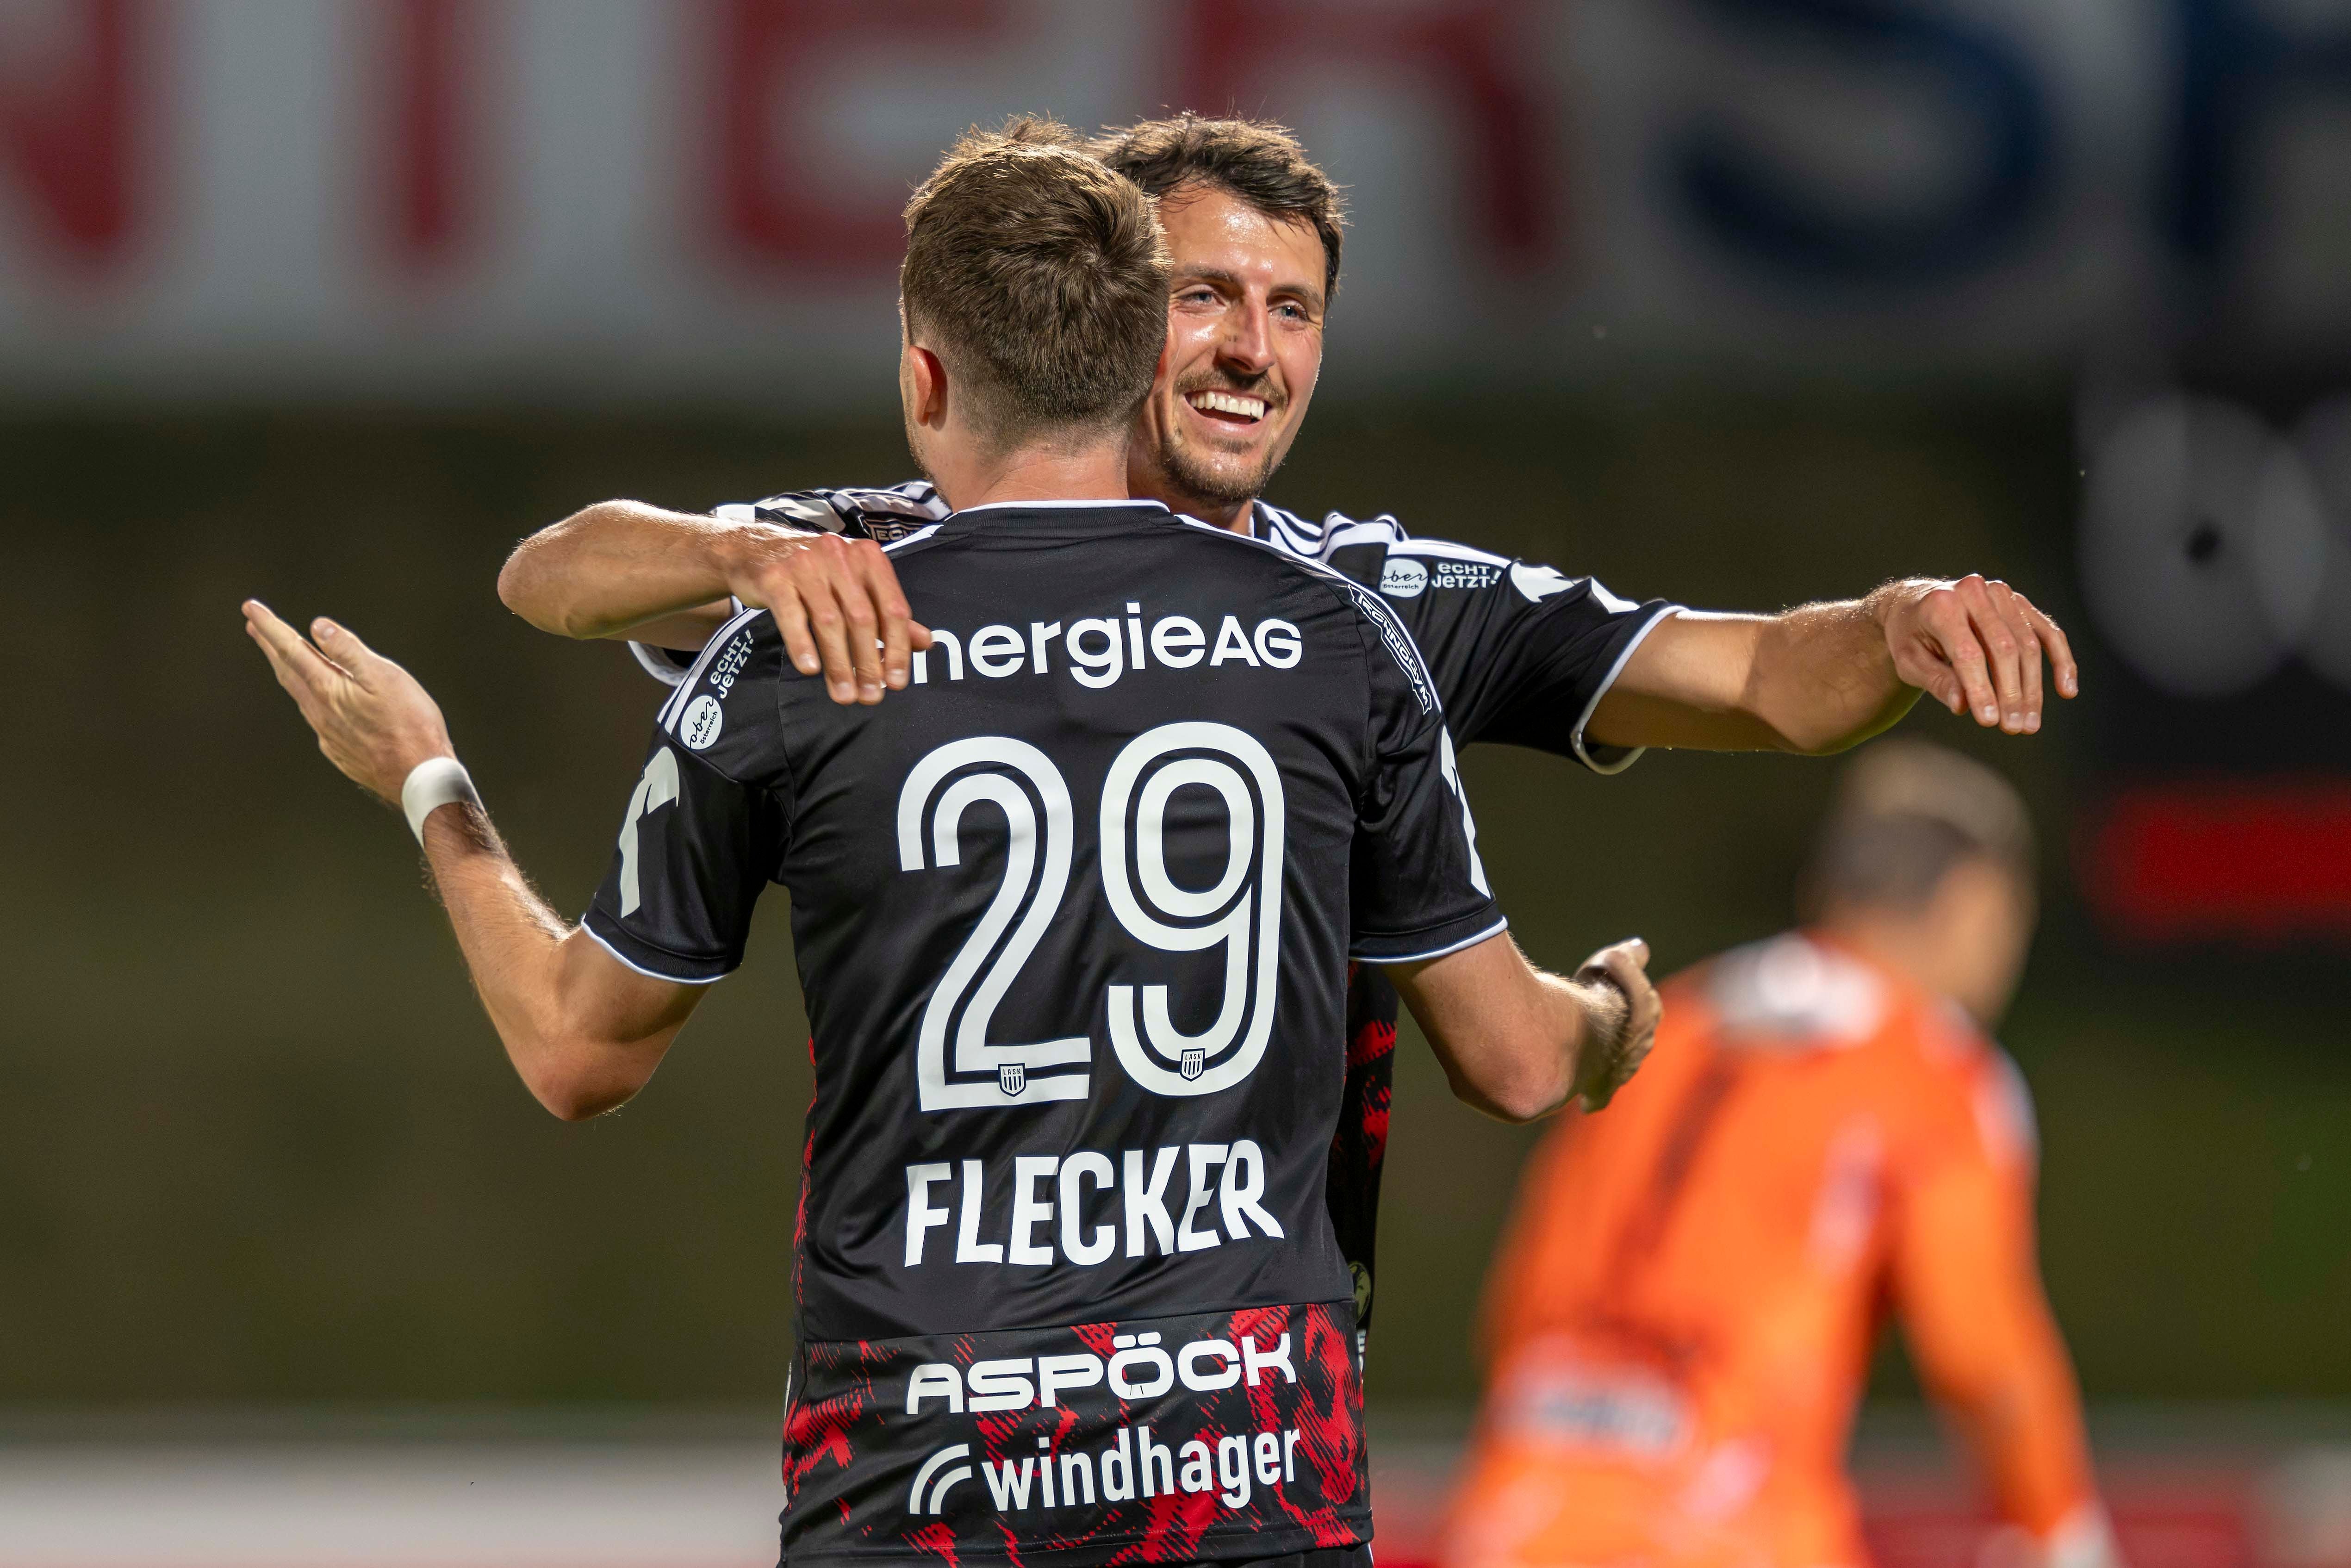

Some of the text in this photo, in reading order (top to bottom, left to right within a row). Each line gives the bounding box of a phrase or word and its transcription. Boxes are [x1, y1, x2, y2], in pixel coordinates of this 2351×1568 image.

[690, 697, 715, 748] ober
[700, 710, 718, 744] österreich
[897, 722, 1285, 1112] 29
[904, 1140, 1285, 1267] FLECKER
[907, 1332, 1296, 1415] ASPÖCK
[981, 1425, 1300, 1511] windhager
